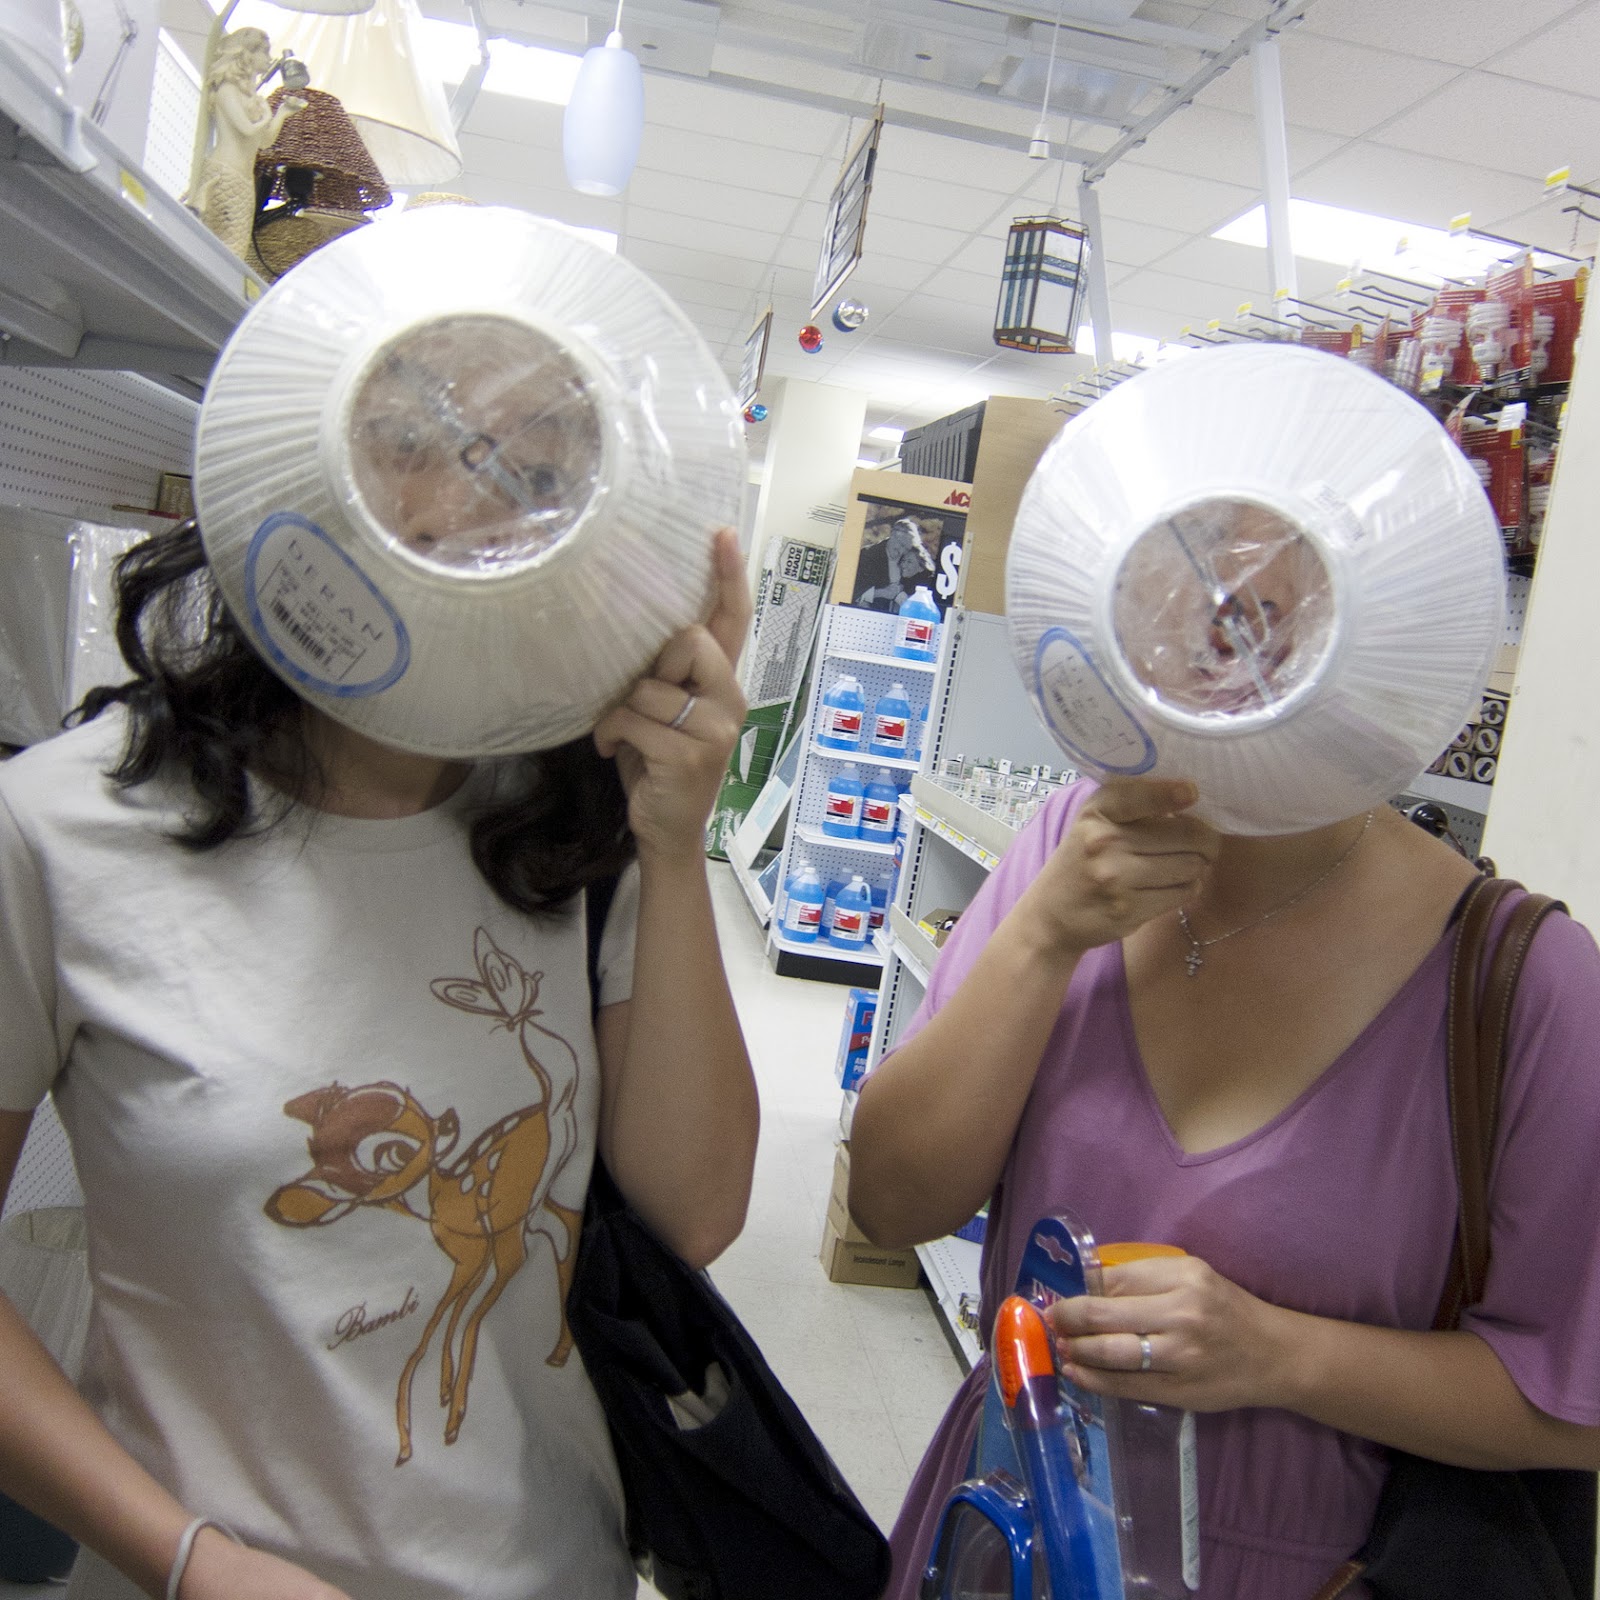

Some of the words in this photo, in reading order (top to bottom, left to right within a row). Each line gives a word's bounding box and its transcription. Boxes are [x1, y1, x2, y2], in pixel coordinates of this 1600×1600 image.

[943, 489, 970, 508] AC
[784, 546, 796, 576] MOTO
[791, 547, 803, 578] SHADE
[936, 541, 962, 600] $
[326, 1286, 420, 1350] Bambi
